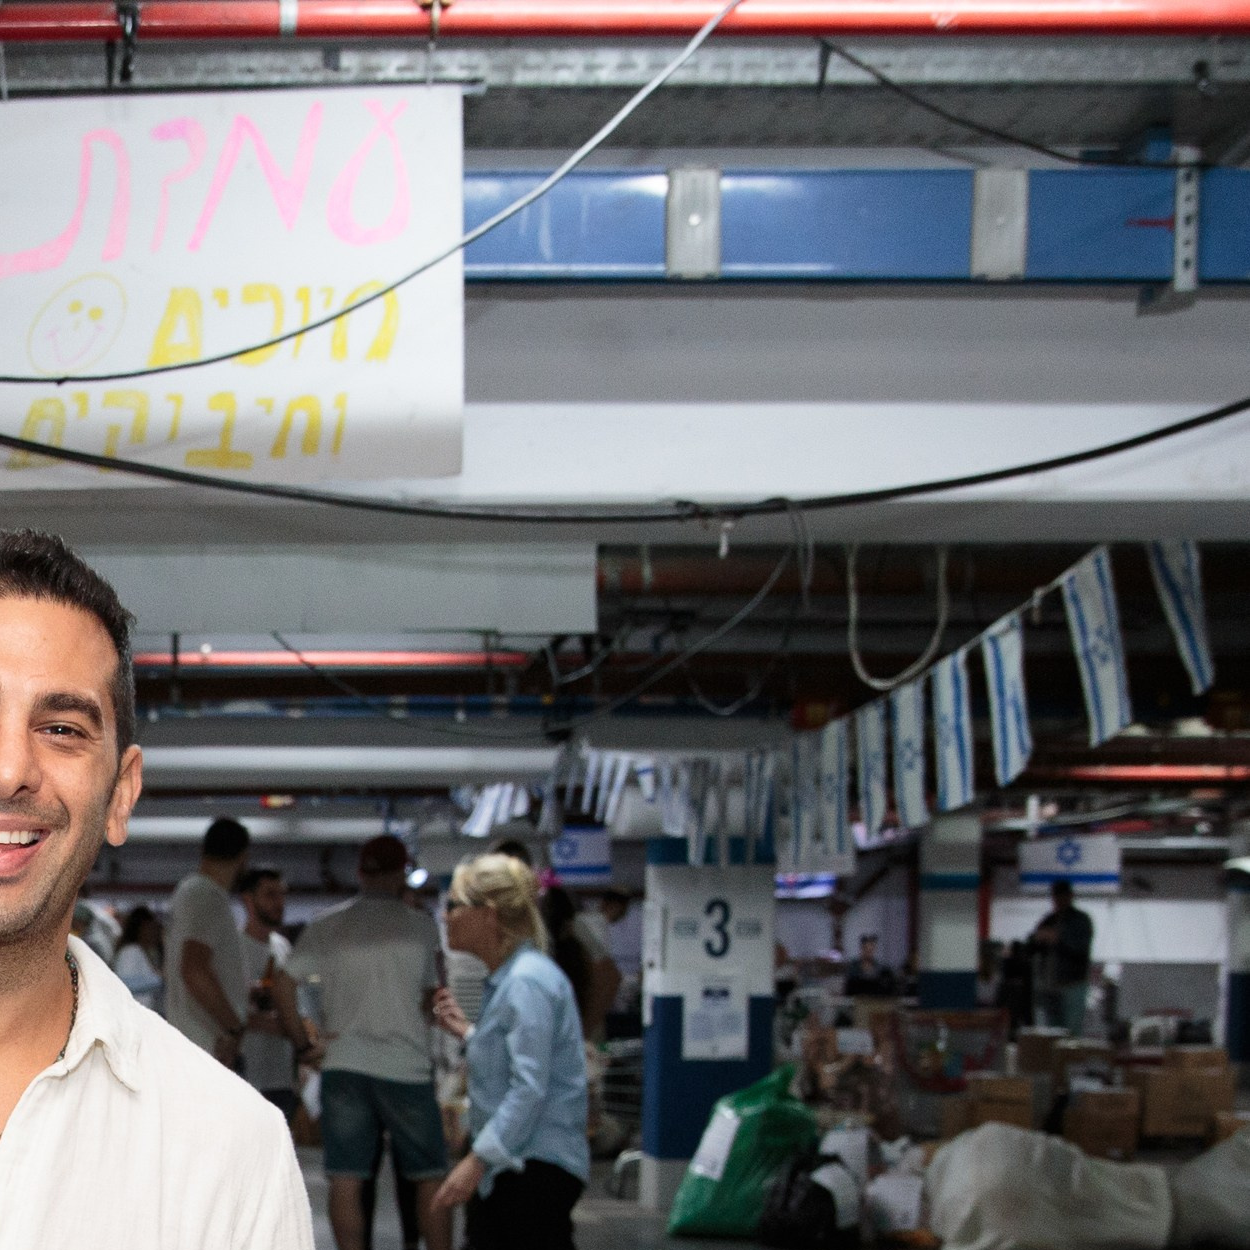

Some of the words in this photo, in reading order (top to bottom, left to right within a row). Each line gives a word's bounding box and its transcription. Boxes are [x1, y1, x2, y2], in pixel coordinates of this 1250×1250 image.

[145, 278, 401, 368] חיוכים
[6, 389, 349, 475] וחיבוקים
[704, 897, 730, 958] 3
